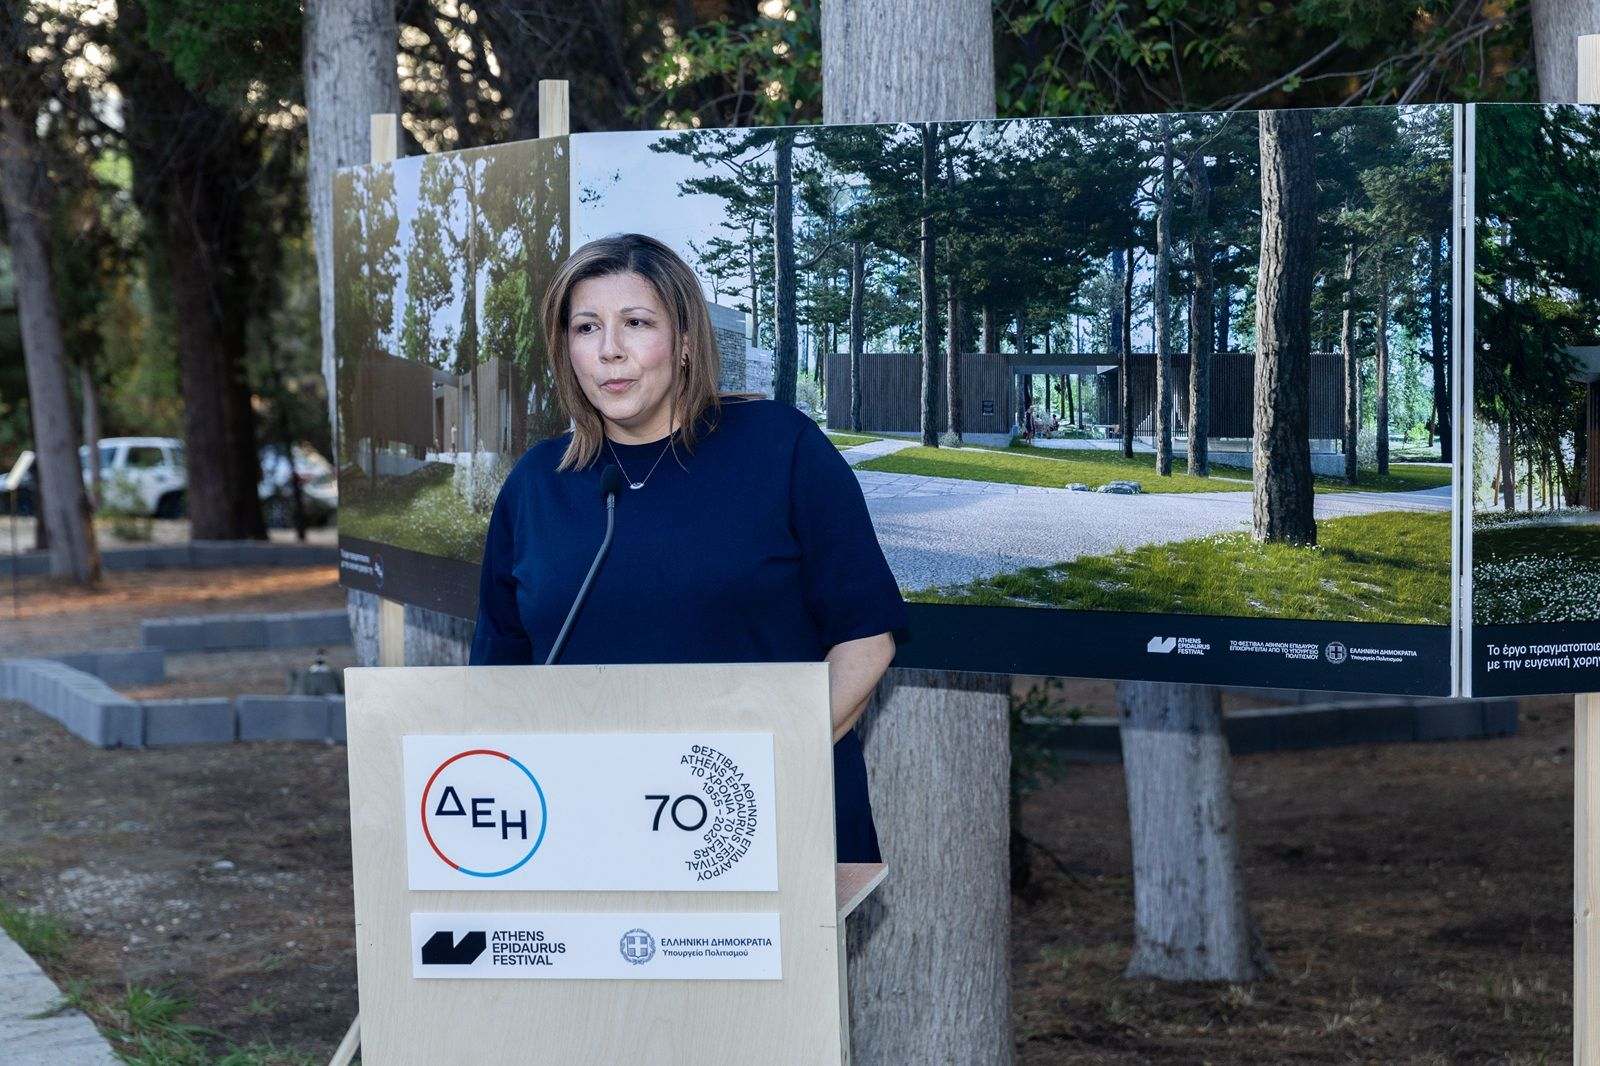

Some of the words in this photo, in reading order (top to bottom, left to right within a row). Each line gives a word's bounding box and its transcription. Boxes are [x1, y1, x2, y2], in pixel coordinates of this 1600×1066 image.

[1487, 644, 1500, 655] Το
[1503, 644, 1527, 657] έργο
[1487, 661, 1500, 672] με
[1503, 660, 1521, 671] την
[1525, 655, 1570, 670] ευγενική
[680, 754, 727, 778] ATHENS
[690, 766, 705, 778] 70
[692, 744, 745, 782] ΦΕΣΤΙΒΑΛ
[702, 782, 723, 807] 1955
[706, 772, 735, 814] ΧΡΟΝΙΑ
[435, 786, 528, 840] ΔΕΗ
[644, 794, 708, 832] 70
[725, 776, 746, 843] EPIDAURUS
[741, 782, 757, 837] ΑΘΗΝΩΝ
[703, 816, 724, 844] 2025
[724, 818, 735, 832] 70
[685, 842, 735, 870] FESTIVAL
[694, 834, 729, 860] YEARS
[697, 838, 752, 882] ΕΠΙΔΑΥΡΟΥ
[492, 931, 544, 941] ATHENS
[493, 943, 566, 953] EPIDAURUS
[661, 938, 709, 946] ΕΛΛΗΝΙΚΗ
[711, 938, 772, 946] ΔΗΜΟΚΡΑΤΙΑ
[493, 955, 553, 965] FESTIVAL
[662, 949, 704, 957] Υπουργείο
[705, 949, 748, 957] Πολιτισμού
